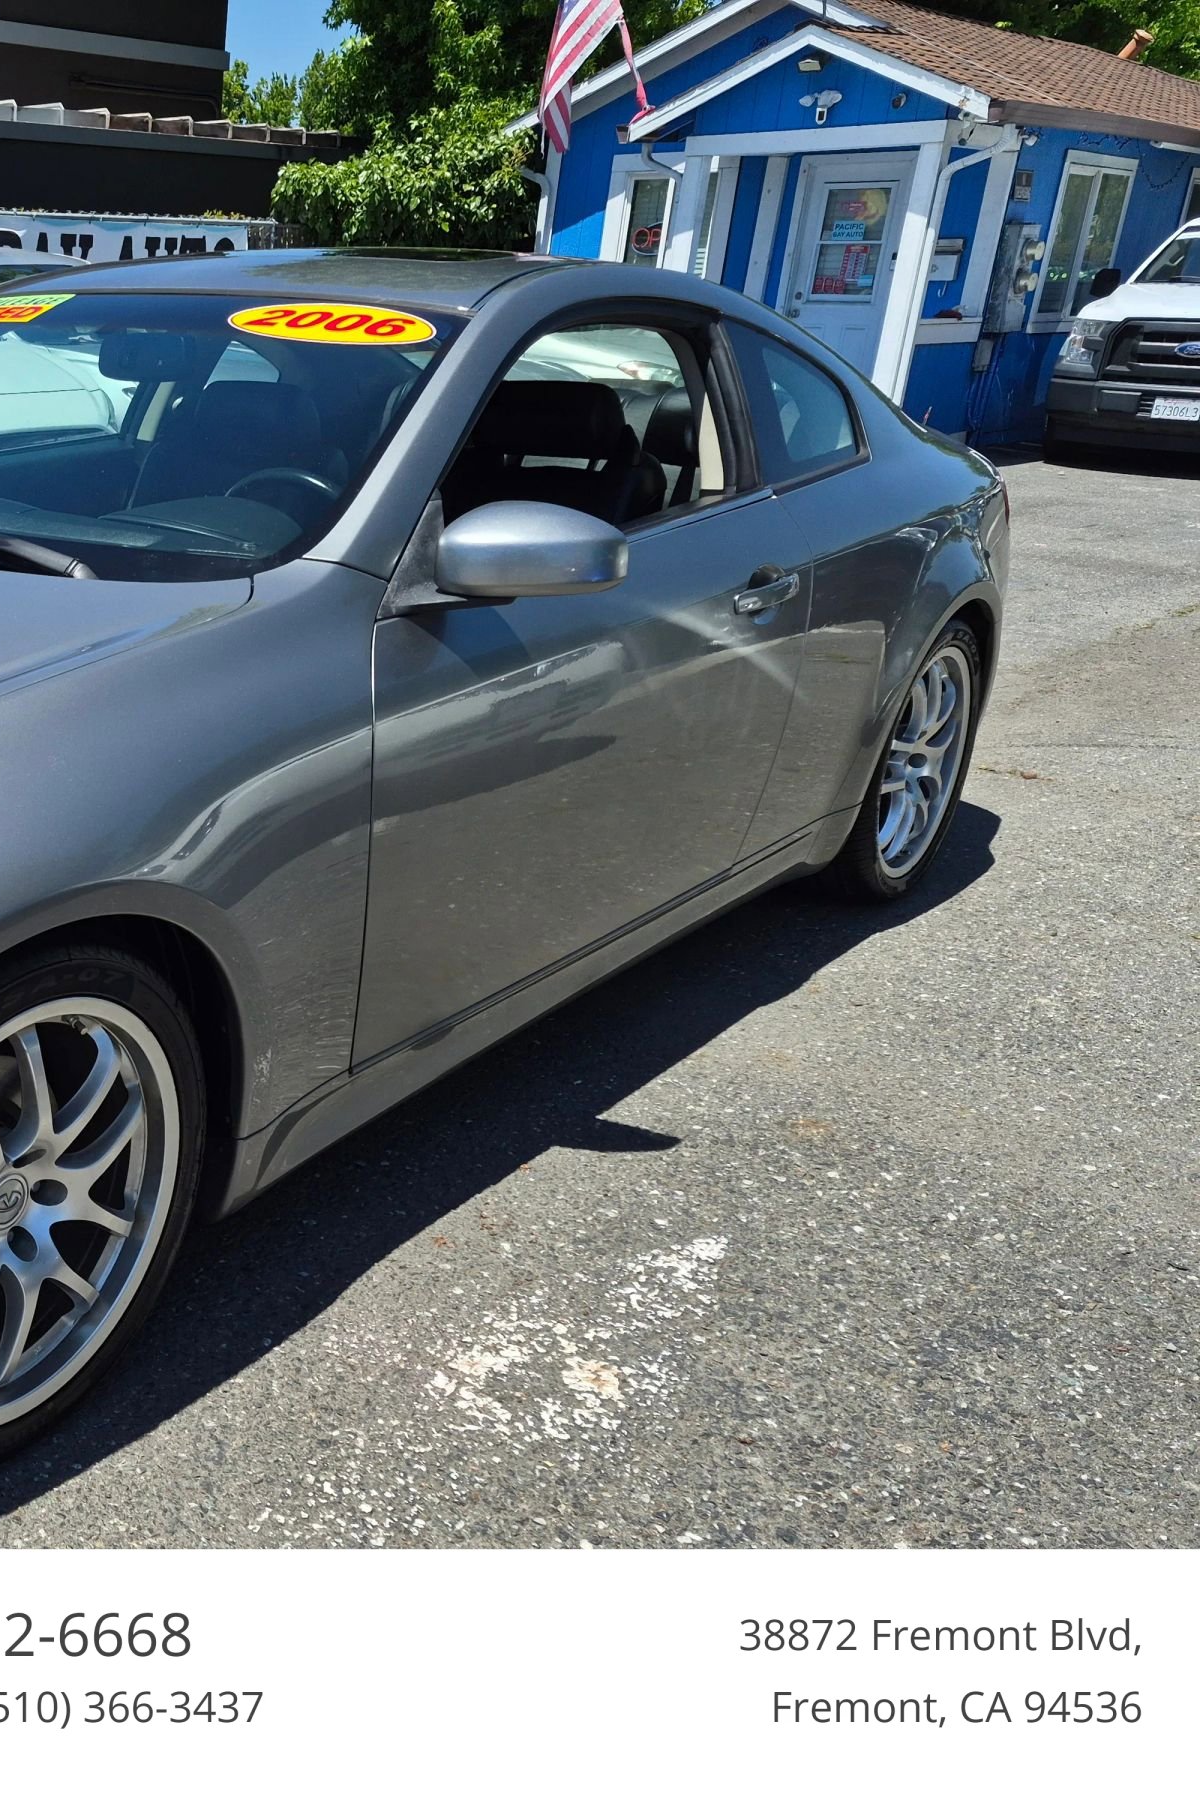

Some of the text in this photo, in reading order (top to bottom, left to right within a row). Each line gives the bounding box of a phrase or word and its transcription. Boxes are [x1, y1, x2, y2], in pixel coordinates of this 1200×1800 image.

[834, 223, 865, 231] PACIFIC
[631, 227, 662, 248] OP
[845, 231, 864, 239] AUTO
[242, 309, 417, 337] 2006
[1154, 404, 1199, 418] 57306L3
